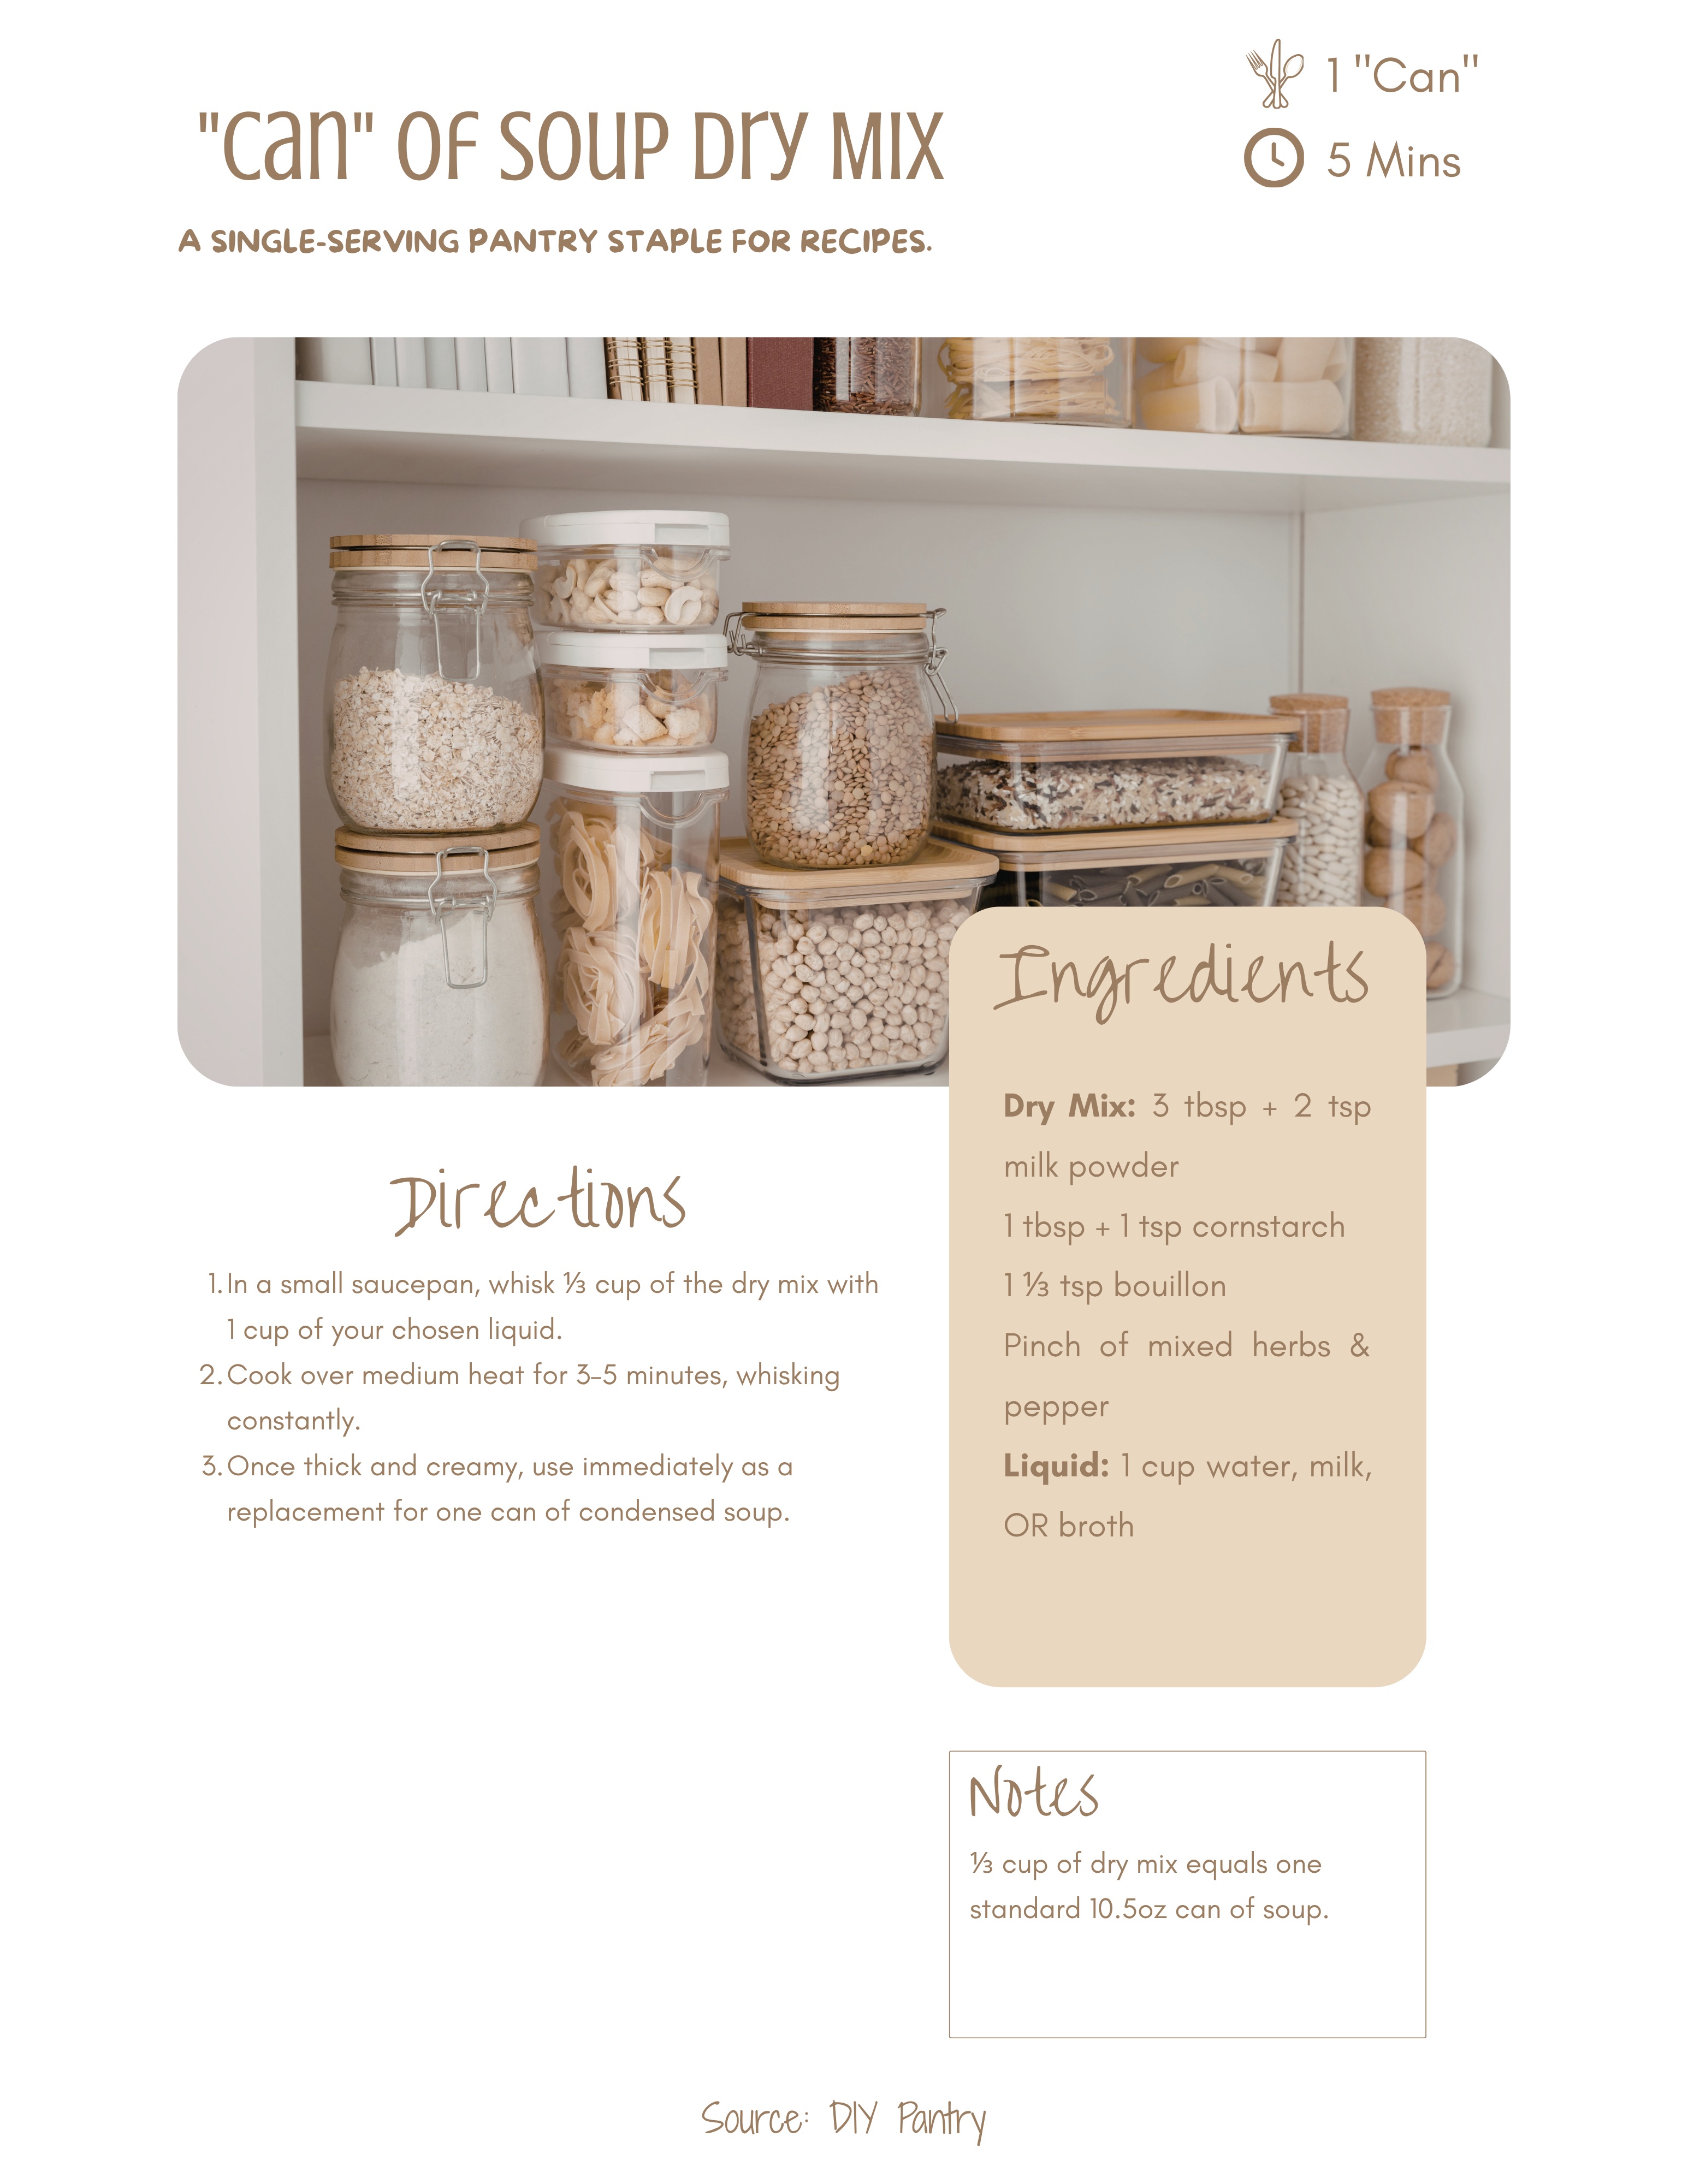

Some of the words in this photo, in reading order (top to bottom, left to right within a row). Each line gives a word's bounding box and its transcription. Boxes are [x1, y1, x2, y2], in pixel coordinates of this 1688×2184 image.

[1328, 57, 1337, 92] 1
[1355, 54, 1478, 93] "Can"
[1328, 142, 1351, 177] 5
[1366, 140, 1461, 179] Mins
[178, 228, 201, 252] A
[211, 228, 459, 254] SINGLE-SERVING
[469, 228, 598, 254] PANTRY
[608, 228, 722, 254] STAPLE
[732, 229, 791, 253] FOR
[801, 228, 932, 254] RECIPES.
[993, 940, 1369, 1025] Ingredients
[1005, 1093, 1056, 1126] Dry
[1068, 1093, 1135, 1118] Mix:
[1153, 1093, 1169, 1118] 3
[1184, 1090, 1246, 1126] tbsp
[1263, 1102, 1277, 1117] +
[1294, 1093, 1311, 1117] 2
[1328, 1095, 1371, 1126] tsp
[1005, 1150, 1059, 1177] milk
[1070, 1150, 1179, 1186] powder
[389, 1165, 686, 1237] Directions
[1004, 1213, 1011, 1237] 1
[1022, 1210, 1085, 1246] tbsp
[1095, 1222, 1110, 1237] +
[1121, 1213, 1128, 1237] 1
[1139, 1215, 1182, 1246] tsp
[1193, 1210, 1345, 1238] cornstarch
[209, 1272, 222, 1294] 1.
[228, 1273, 247, 1293] In
[257, 1279, 271, 1294] a
[281, 1271, 342, 1294] small
[352, 1279, 480, 1301] saucepan,
[488, 1271, 555, 1295] whisk
[595, 1279, 641, 1301] cup
[650, 1271, 675, 1294] of
[683, 1271, 723, 1294] the
[732, 1271, 770, 1301] dry
[779, 1275, 819, 1293] mix
[827, 1271, 878, 1295] with
[1004, 1272, 1011, 1297] 1
[1059, 1275, 1103, 1305] tsp
[1115, 1270, 1225, 1297] bouillon
[228, 1318, 234, 1339] 1
[244, 1325, 289, 1346] cup
[298, 1316, 323, 1340] of
[331, 1325, 384, 1346] your
[392, 1316, 479, 1340] chosen
[489, 1316, 562, 1346] liquid.
[1005, 1330, 1080, 1357] Pinch
[1100, 1330, 1129, 1357] of
[1149, 1330, 1232, 1357] mixed
[1253, 1330, 1331, 1357] herbs
[1350, 1332, 1370, 1357] &
[199, 1363, 222, 1385] 2.
[227, 1362, 292, 1385] Cook
[301, 1370, 354, 1386] over
[363, 1362, 459, 1385] medium
[469, 1362, 525, 1385] heat
[533, 1362, 568, 1385] for
[627, 1366, 727, 1389] minutes,
[736, 1362, 839, 1392] whisking
[227, 1407, 360, 1437] constantly.
[1005, 1400, 1109, 1426] pepper
[202, 1455, 222, 1476] 3.
[227, 1455, 295, 1476] Once
[304, 1453, 362, 1476] thick
[370, 1453, 416, 1476] and
[427, 1462, 523, 1483] creamy,
[533, 1462, 573, 1476] use
[583, 1453, 734, 1483] immediately
[742, 1462, 769, 1476] as
[778, 1462, 792, 1476] a
[1005, 1450, 1109, 1486] Liquid:
[1122, 1452, 1129, 1477] 1
[1142, 1461, 1195, 1486] cup
[1206, 1455, 1298, 1482] water,
[1311, 1450, 1372, 1482] milk,
[228, 1498, 385, 1528] replacement
[393, 1498, 428, 1522] for
[436, 1507, 482, 1522] one
[491, 1507, 536, 1522] can
[545, 1498, 571, 1522] of
[579, 1498, 714, 1522] condensed
[724, 1507, 789, 1528] soup.
[1004, 1512, 1048, 1538] OR
[1059, 1510, 1133, 1538] broth
[970, 1764, 1099, 1817] Notes
[1003, 1859, 1048, 1880] cup
[1057, 1850, 1082, 1874] of
[1091, 1850, 1129, 1880] dry
[1138, 1855, 1177, 1873] mix
[1186, 1850, 1268, 1880] equals
[1276, 1859, 1322, 1874] one
[970, 1896, 1080, 1919] standard
[1090, 1897, 1167, 1919] 10.5oz
[1175, 1904, 1220, 1919] can
[1230, 1896, 1255, 1919] of
[1263, 1904, 1328, 1926] soup.
[701, 2100, 808, 2135] Source:
[829, 2099, 878, 2134] DIY
[897, 2100, 986, 2146] Pantry
